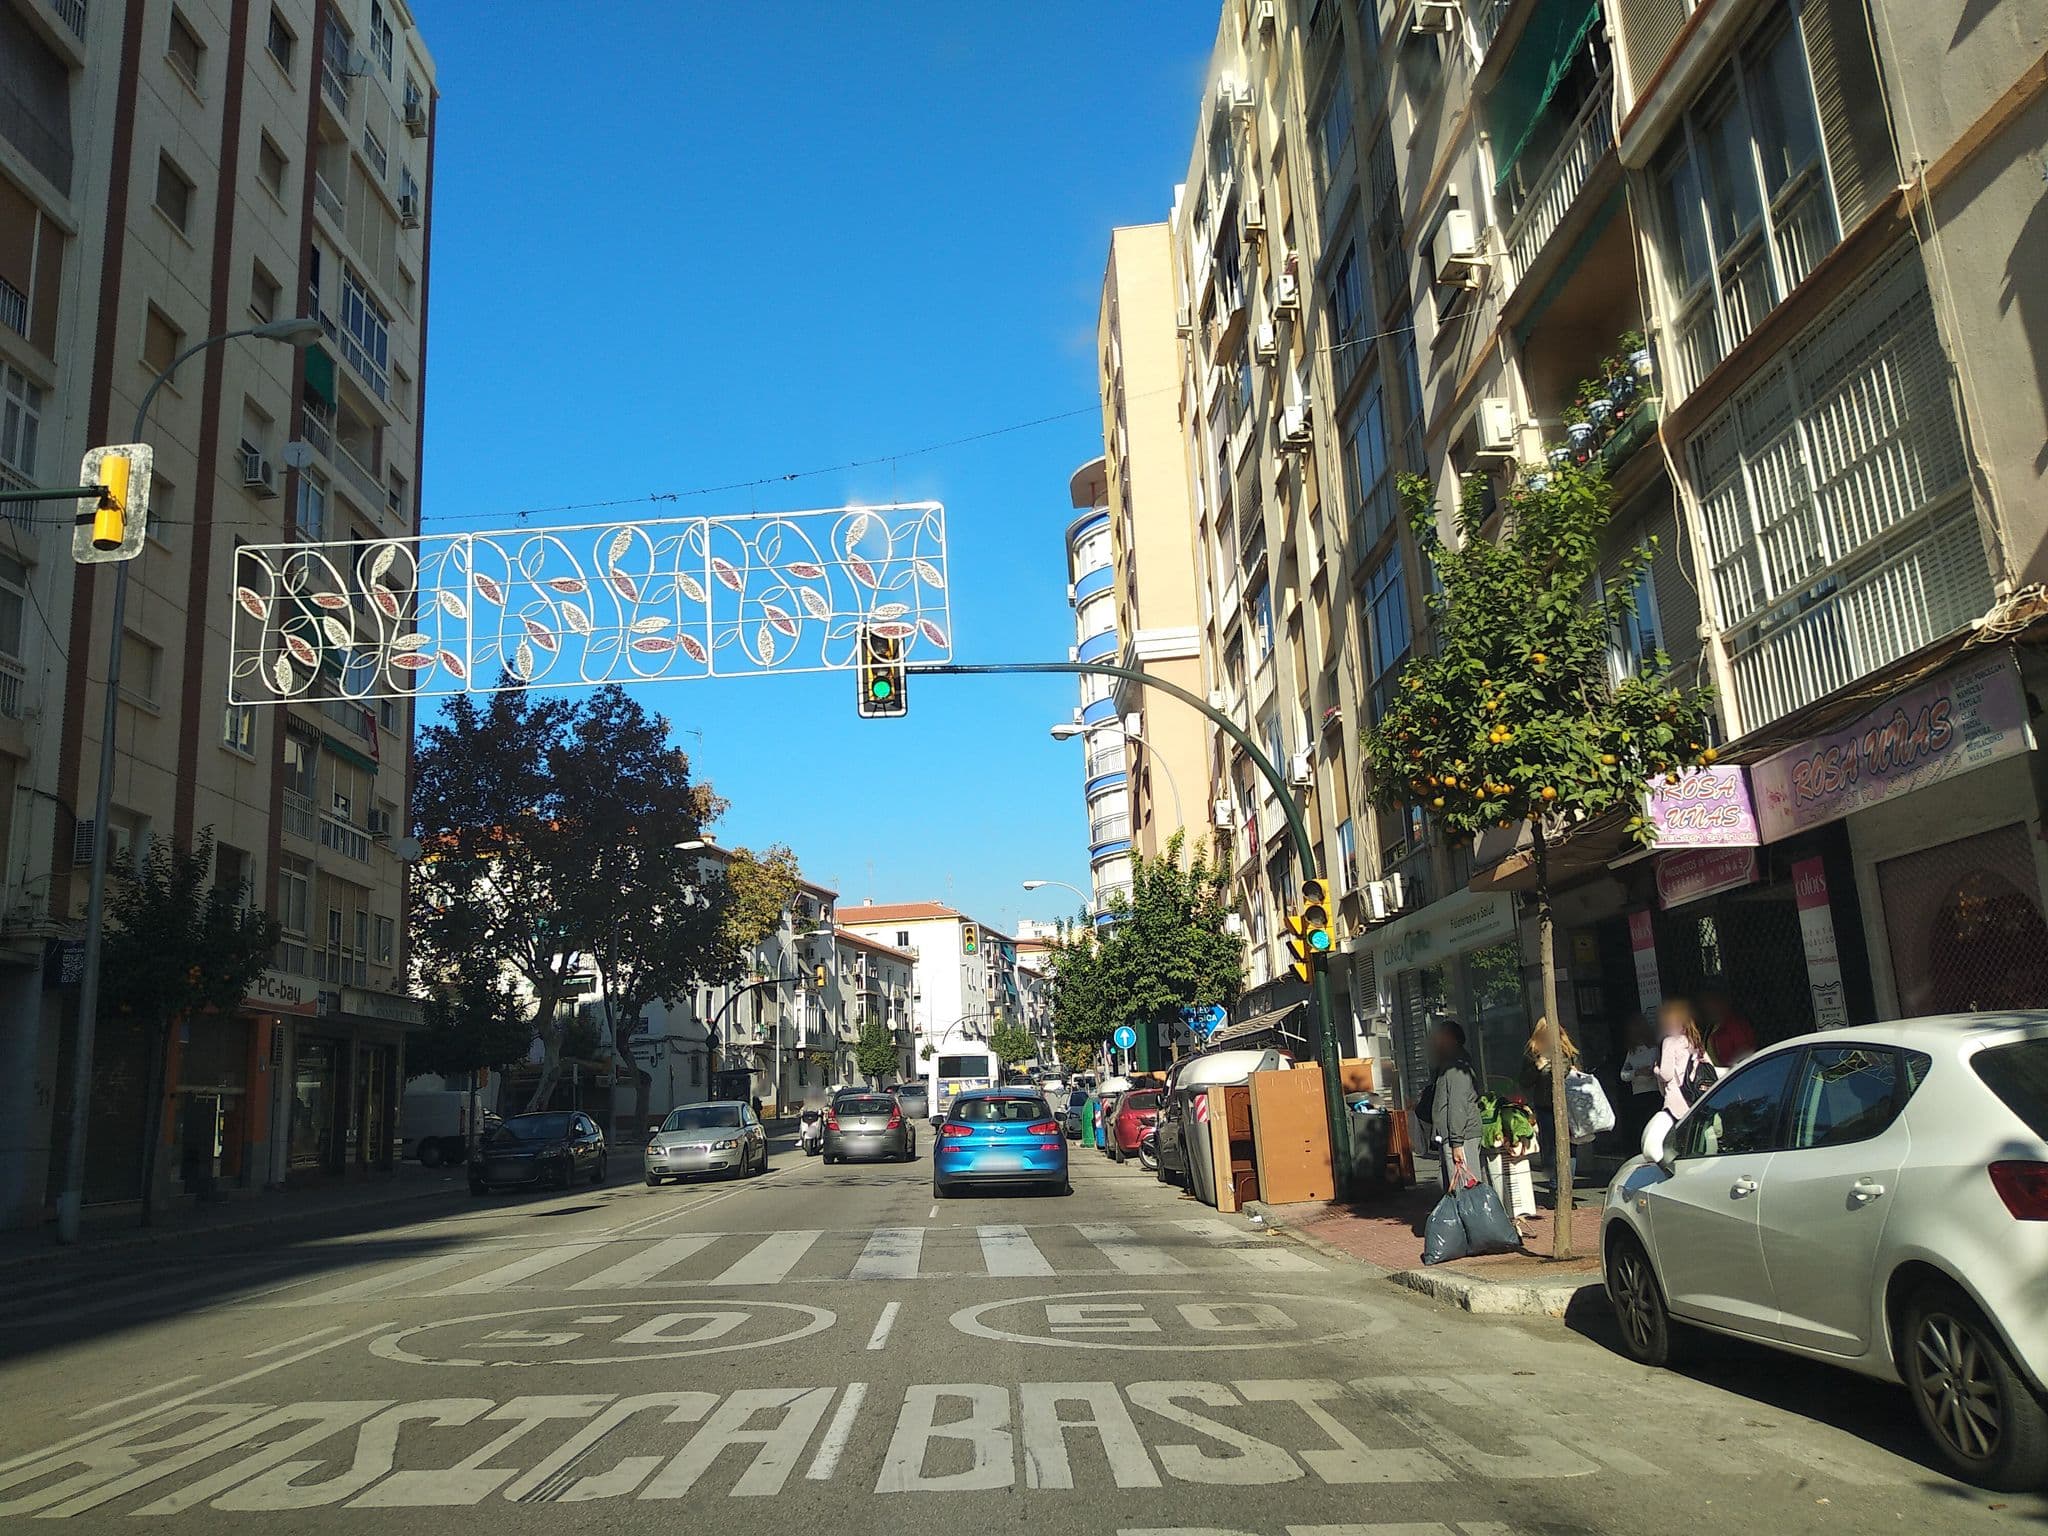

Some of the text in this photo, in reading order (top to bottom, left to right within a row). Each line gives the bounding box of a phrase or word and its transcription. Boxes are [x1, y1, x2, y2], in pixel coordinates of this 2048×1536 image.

[1792, 697, 1953, 806] ROSA UÑAS
[1660, 774, 1737, 802] ROSA
[1663, 801, 1741, 829] UÑAS
[257, 976, 301, 1005] PC-bay
[1046, 1303, 1296, 1332] 50
